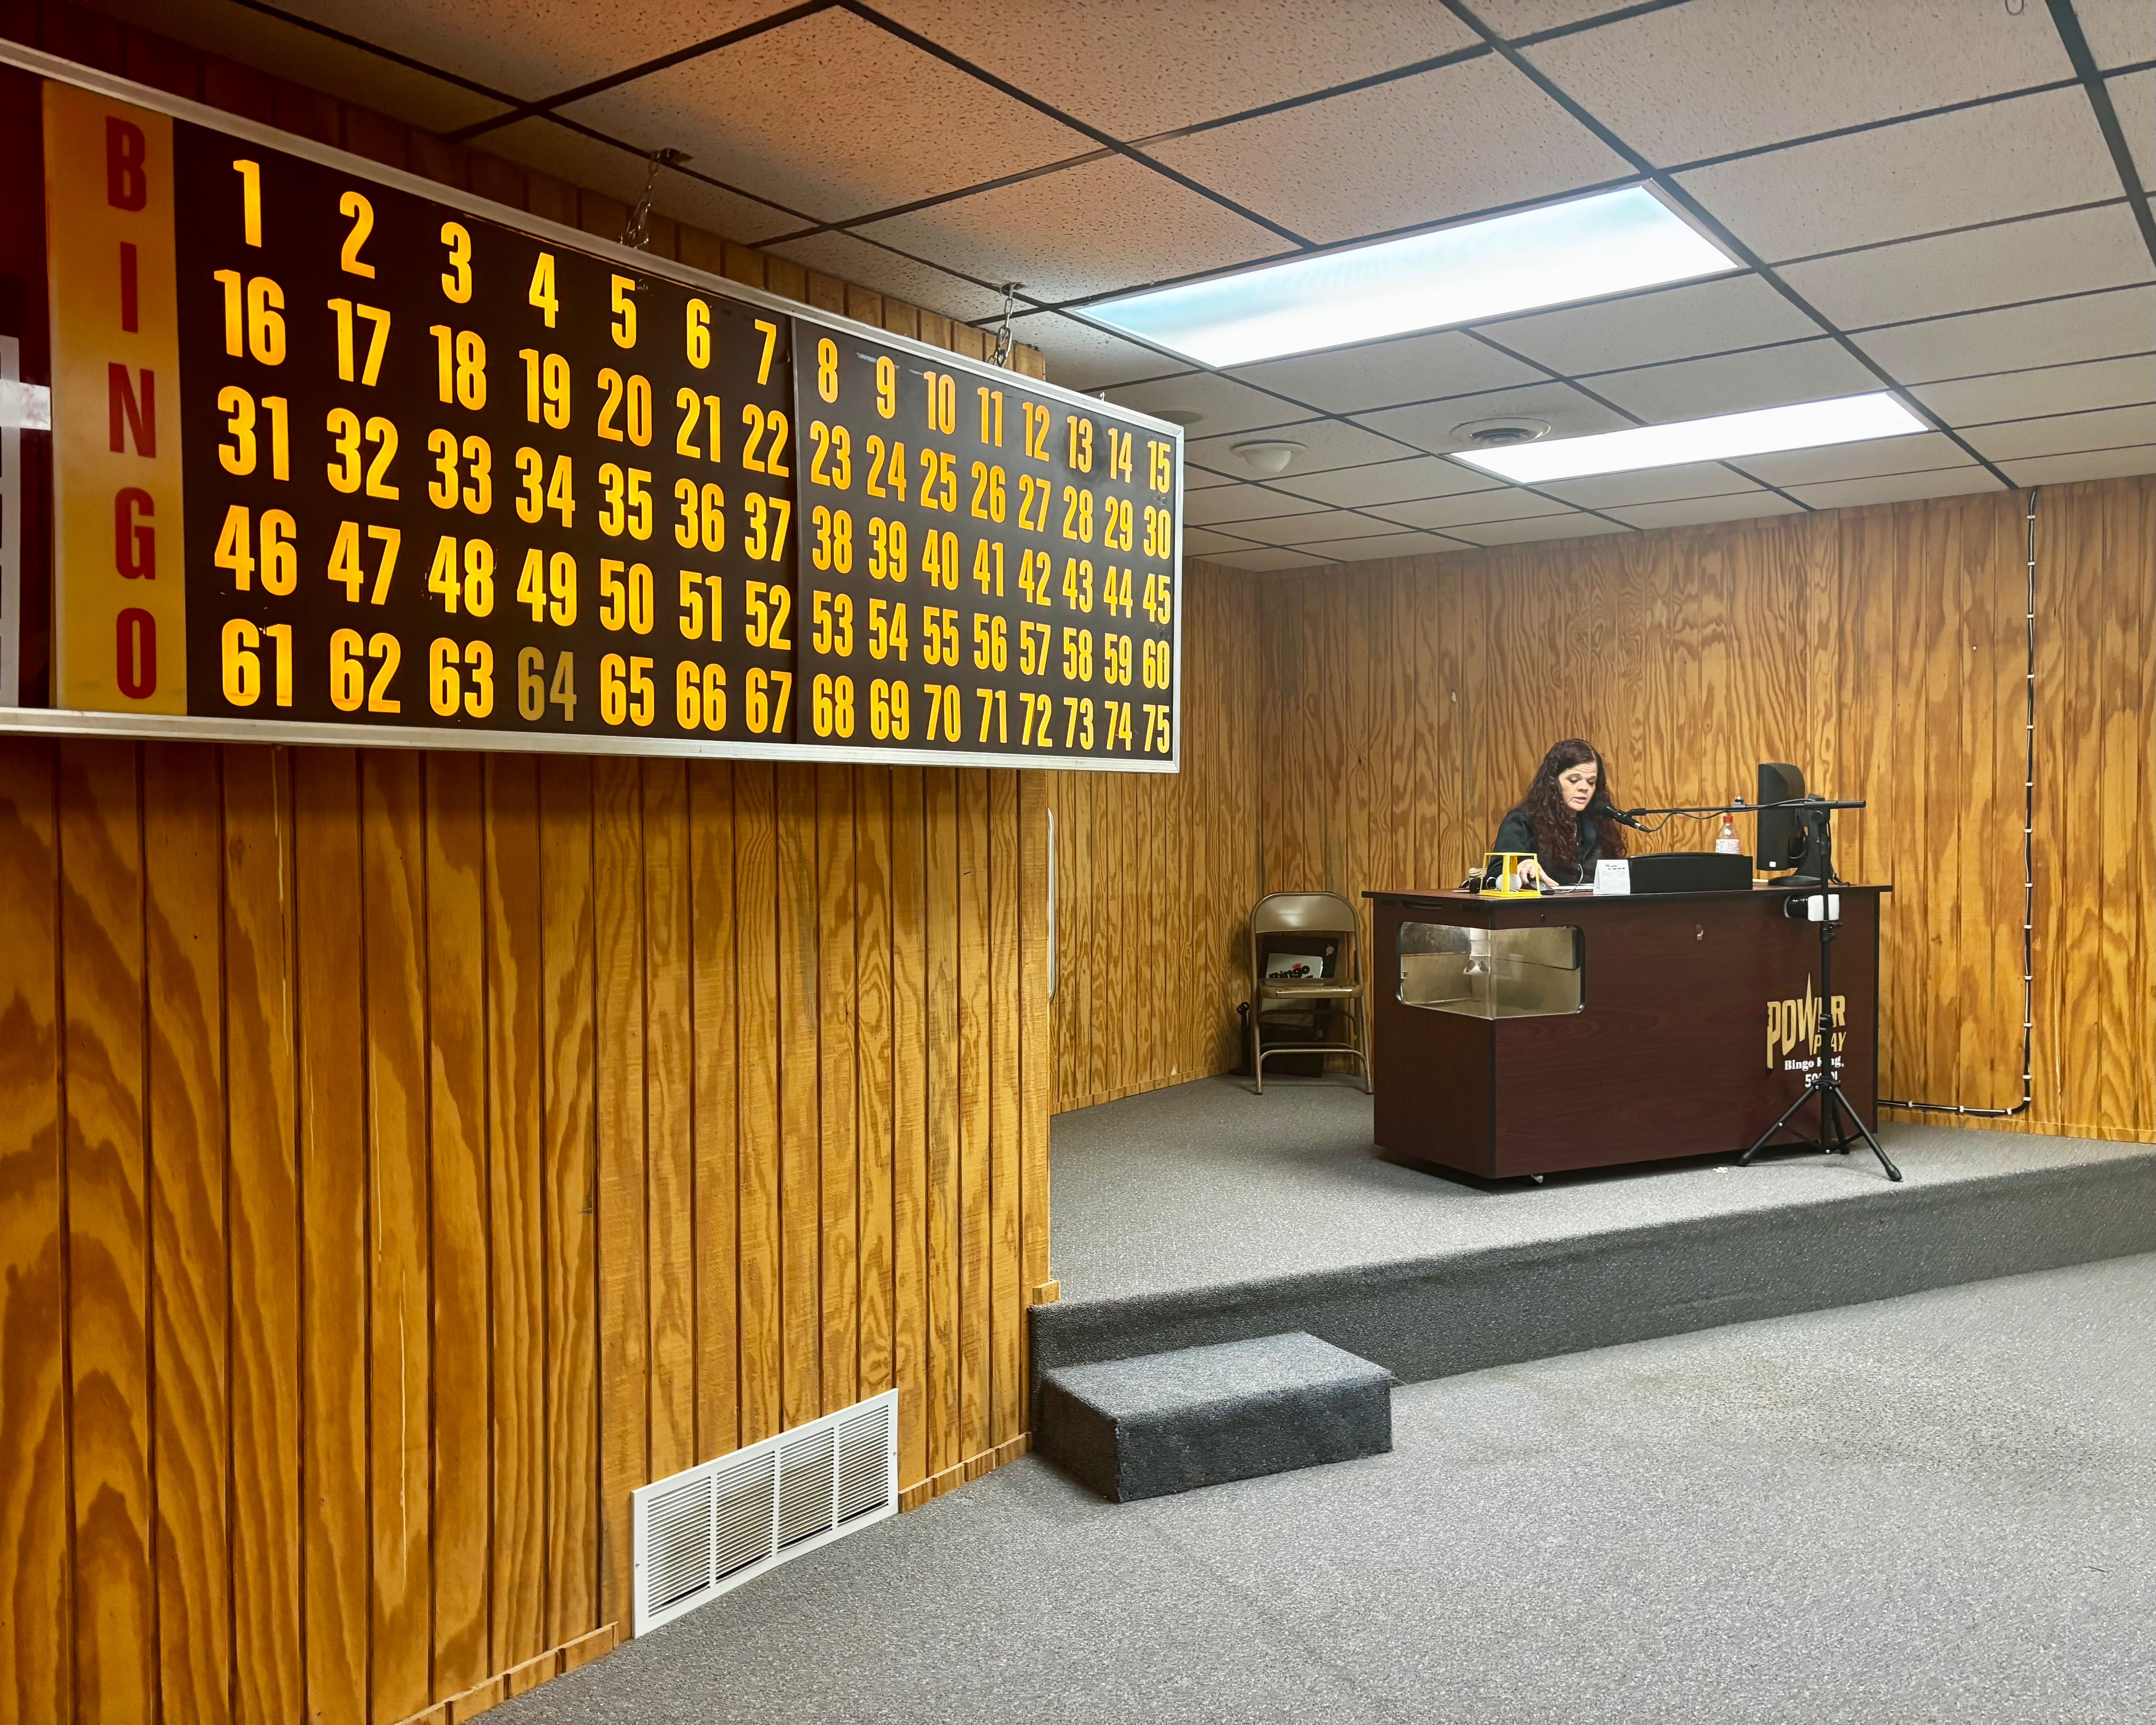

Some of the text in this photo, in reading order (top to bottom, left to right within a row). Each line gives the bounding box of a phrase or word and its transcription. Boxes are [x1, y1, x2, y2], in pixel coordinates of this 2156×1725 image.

[234, 160, 1170, 492] 1 2 3 4 5 6 7 8 9 10 11 12 13 14 15
[214, 269, 1171, 558] 16 17 18 19 20 21 22 23 24 25 26 27 28 29 30
[218, 386, 1170, 624] 31 32 33 34 35 36 37 38 39 40 41 42 43 44 45
[215, 505, 1170, 689] 46 47 48 49 50 51 52 53 54 55 56 57 58 59 60
[222, 619, 1170, 753] 61 62 63 64 65 66 67 68 69 70 71 72 73 74 75
[1767, 972, 1846, 1069] POWR
[1784, 1060, 1814, 1071] Bingo
[1813, 1031, 1847, 1055] PAY
